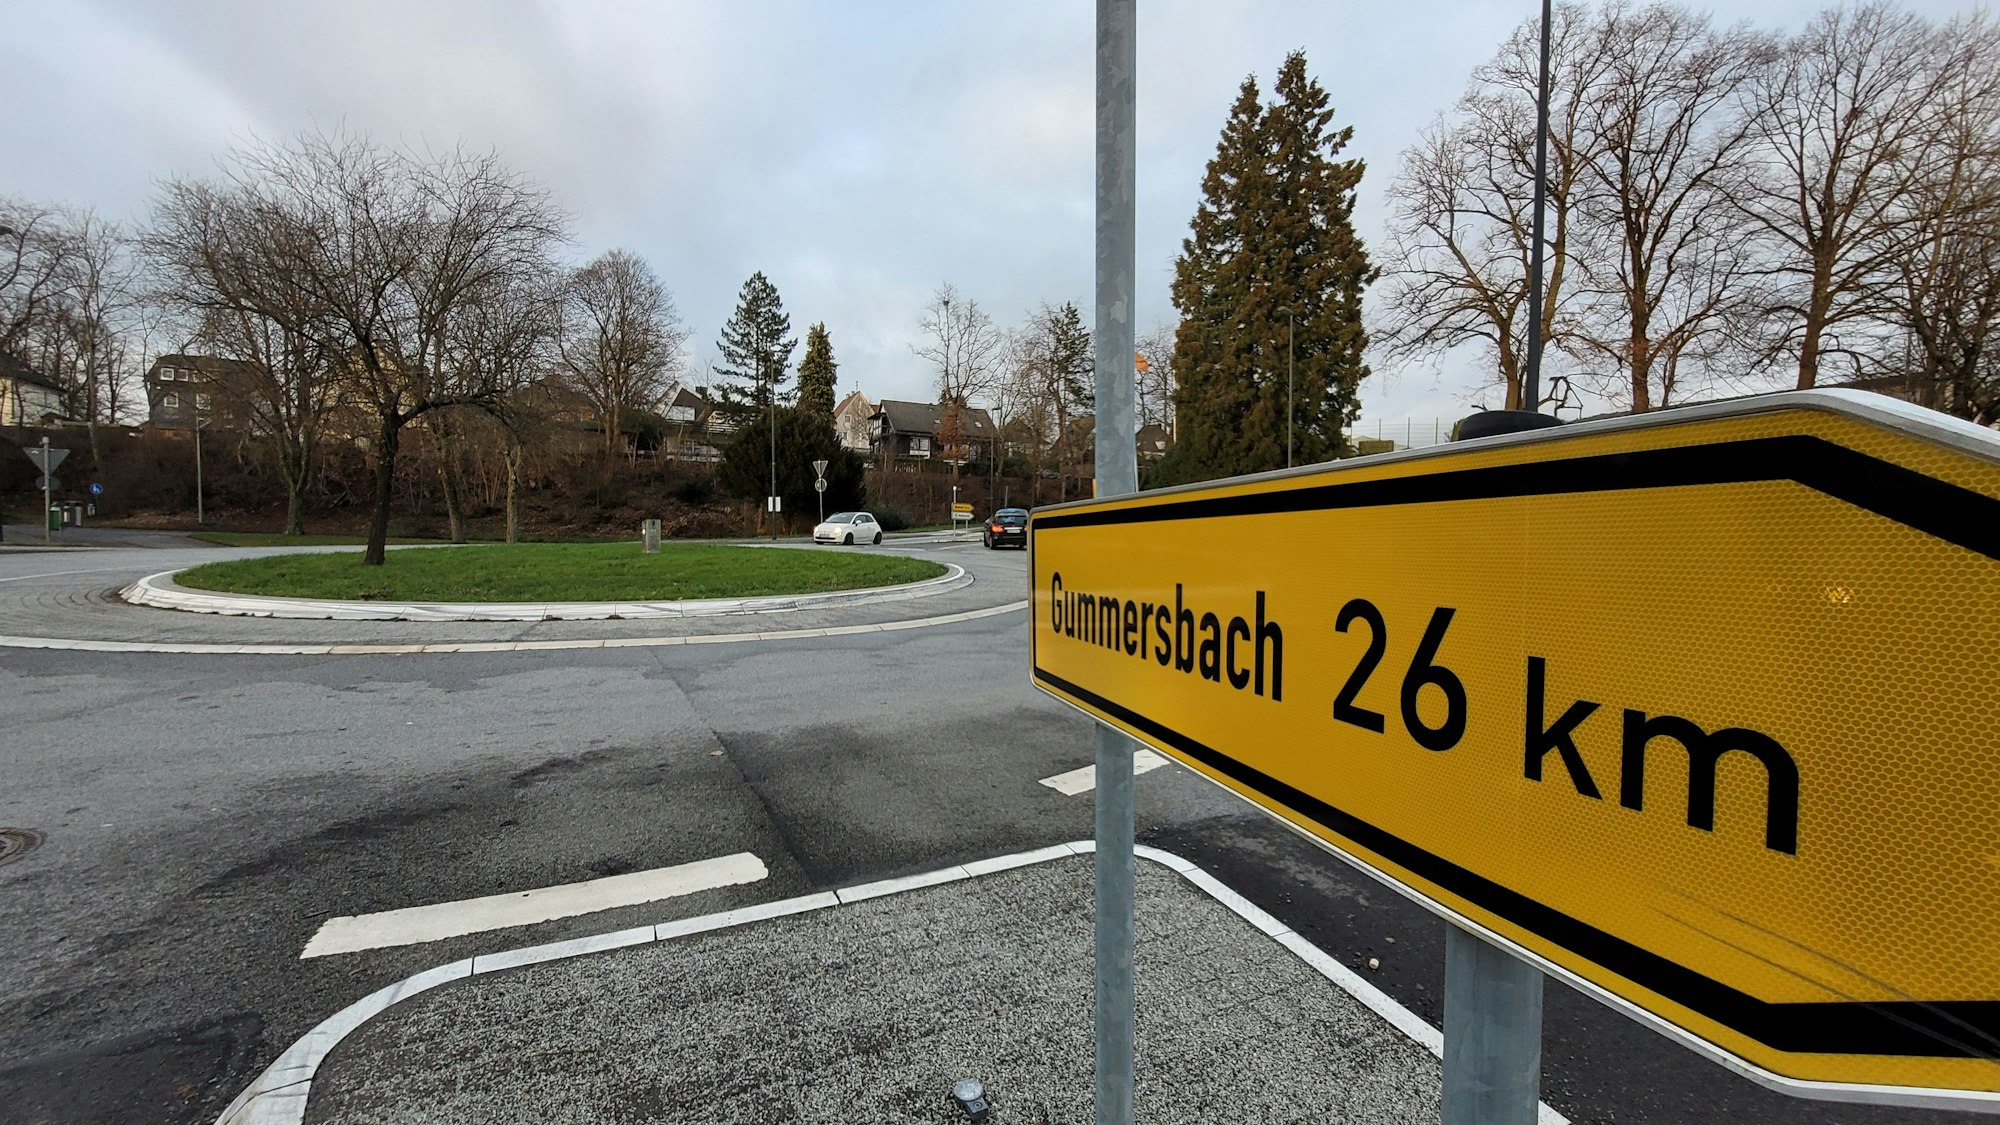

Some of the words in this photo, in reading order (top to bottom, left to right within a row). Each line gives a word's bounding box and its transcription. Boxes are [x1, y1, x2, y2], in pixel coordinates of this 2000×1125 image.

[1051, 571, 1283, 702] Gummersbach
[1333, 598, 1467, 752] 26
[1524, 656, 1801, 857] km
